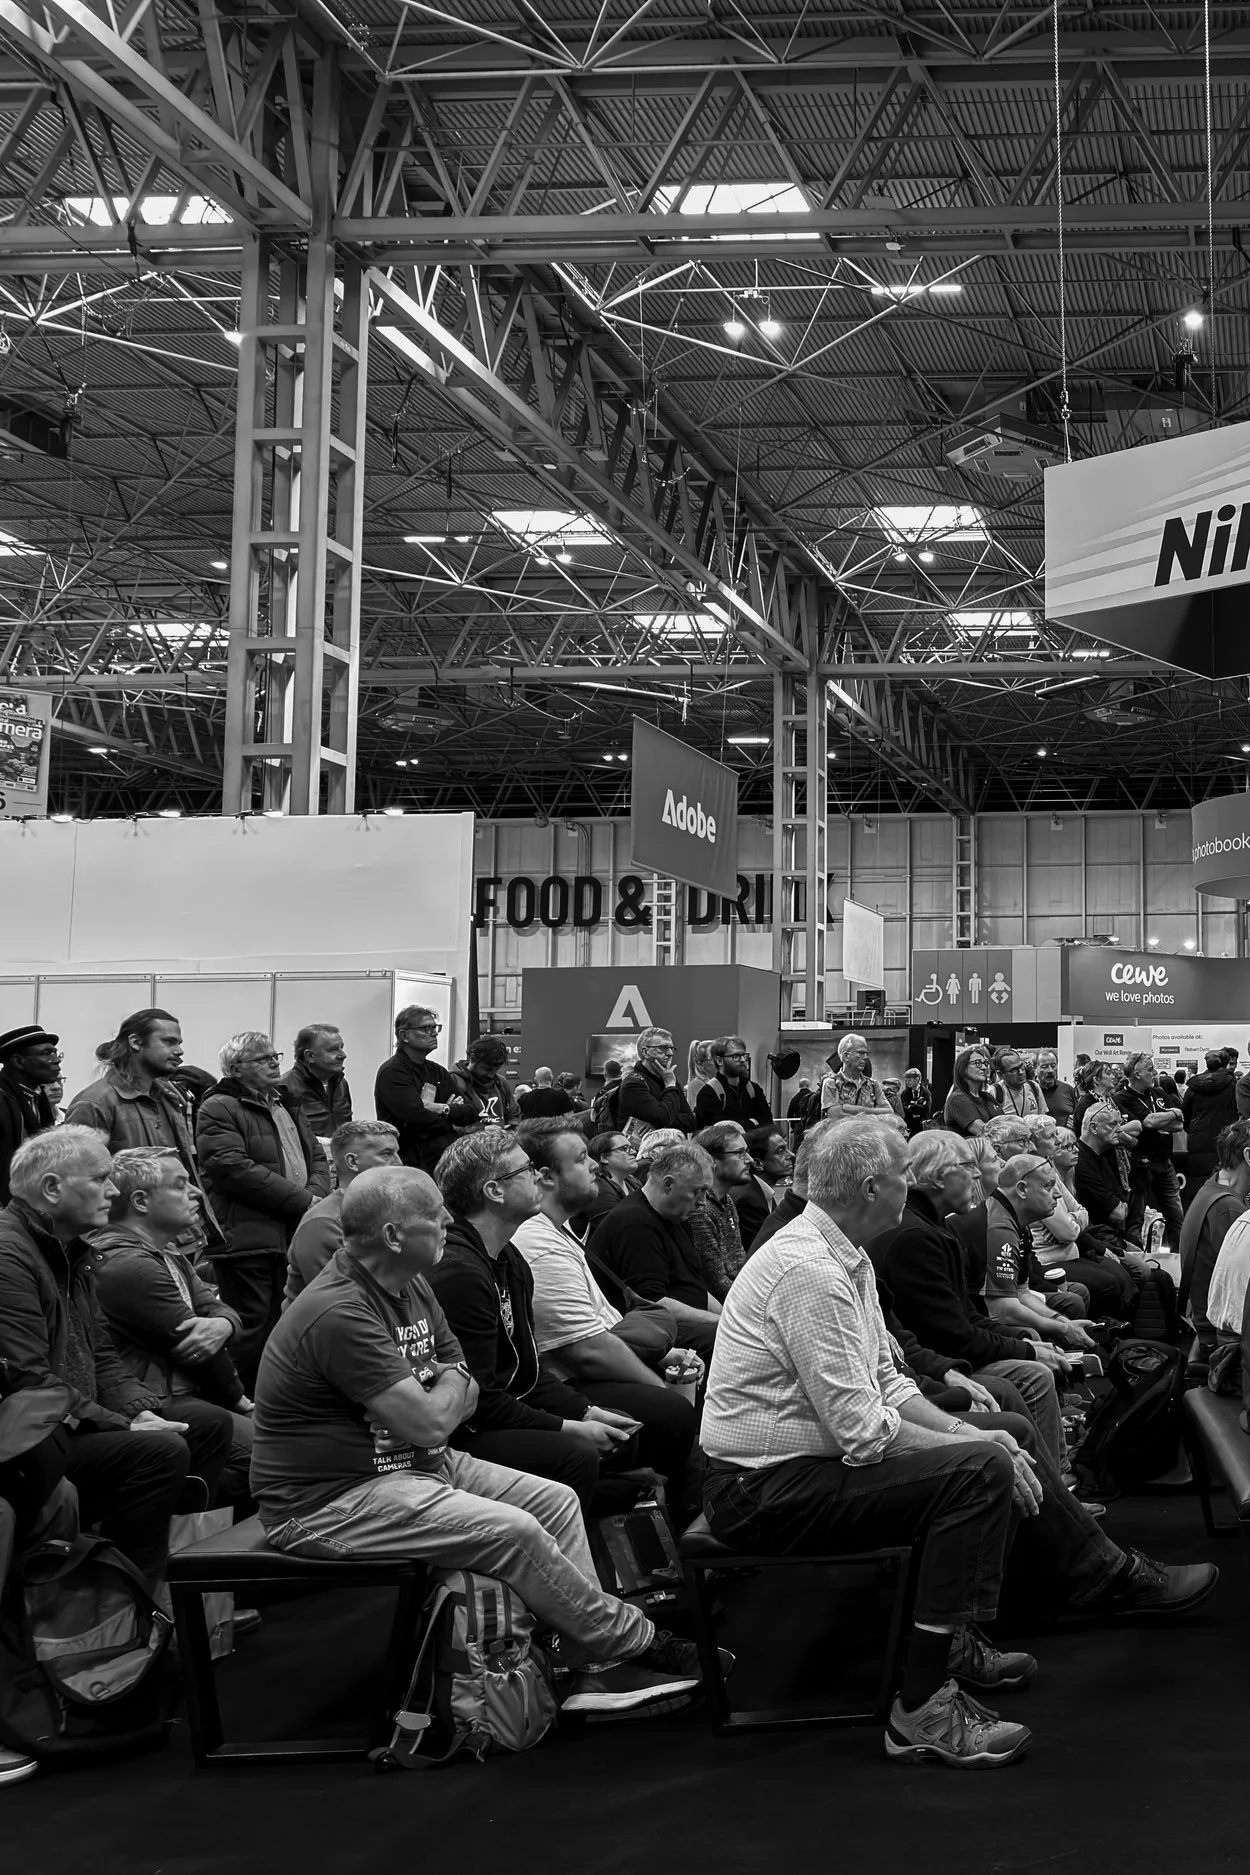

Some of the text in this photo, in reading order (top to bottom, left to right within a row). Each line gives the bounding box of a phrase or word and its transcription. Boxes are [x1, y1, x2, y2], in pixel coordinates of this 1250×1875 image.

[661, 788, 716, 843] Adobe
[475, 873, 834, 928] FOOD & DRI
[1111, 962, 1169, 987] cewe
[1105, 989, 1175, 1005] we love photos
[373, 1451, 415, 1465] TALK ABOUT
[377, 1460, 412, 1472] CAMERAS
